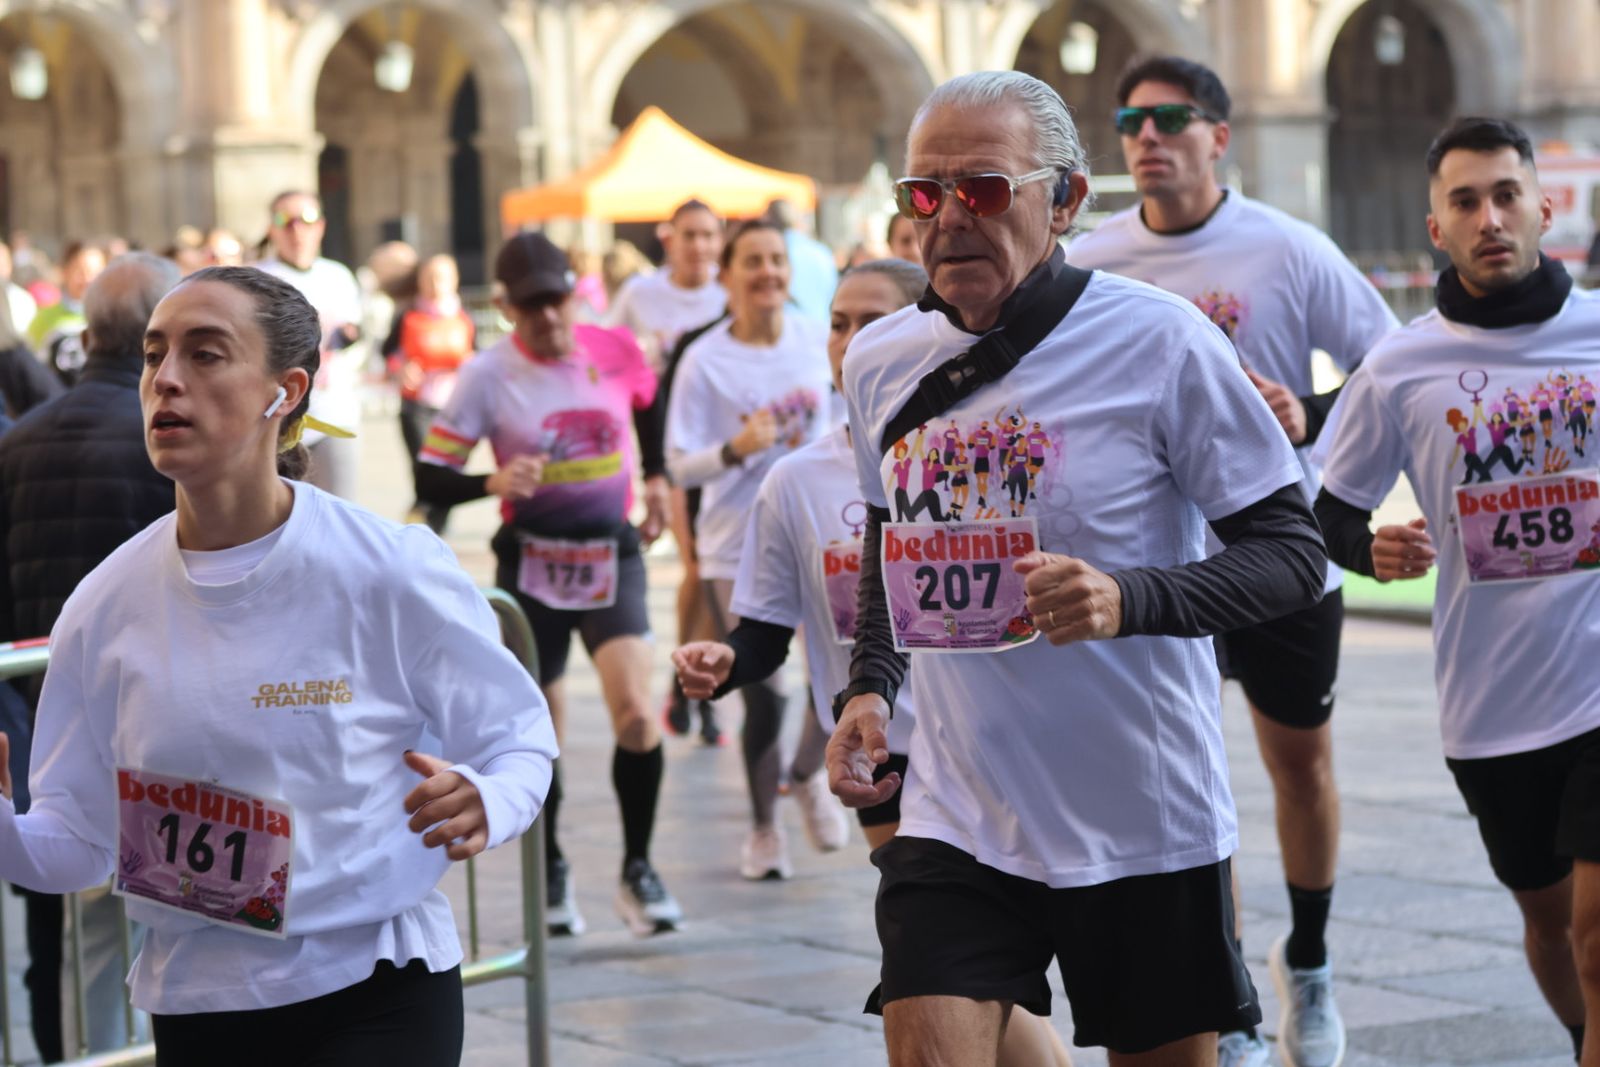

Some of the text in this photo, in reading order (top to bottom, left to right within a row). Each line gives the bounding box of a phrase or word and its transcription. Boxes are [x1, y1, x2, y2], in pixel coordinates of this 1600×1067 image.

[1457, 477, 1599, 516] bedunia
[885, 527, 1034, 562] bedunia
[1493, 507, 1574, 550] 458
[546, 563, 594, 588] 178
[915, 563, 1001, 611] 207
[251, 691, 352, 708] TRAINING
[258, 679, 348, 696] GALENA
[117, 771, 290, 838] bedunia
[158, 813, 247, 882] 161
